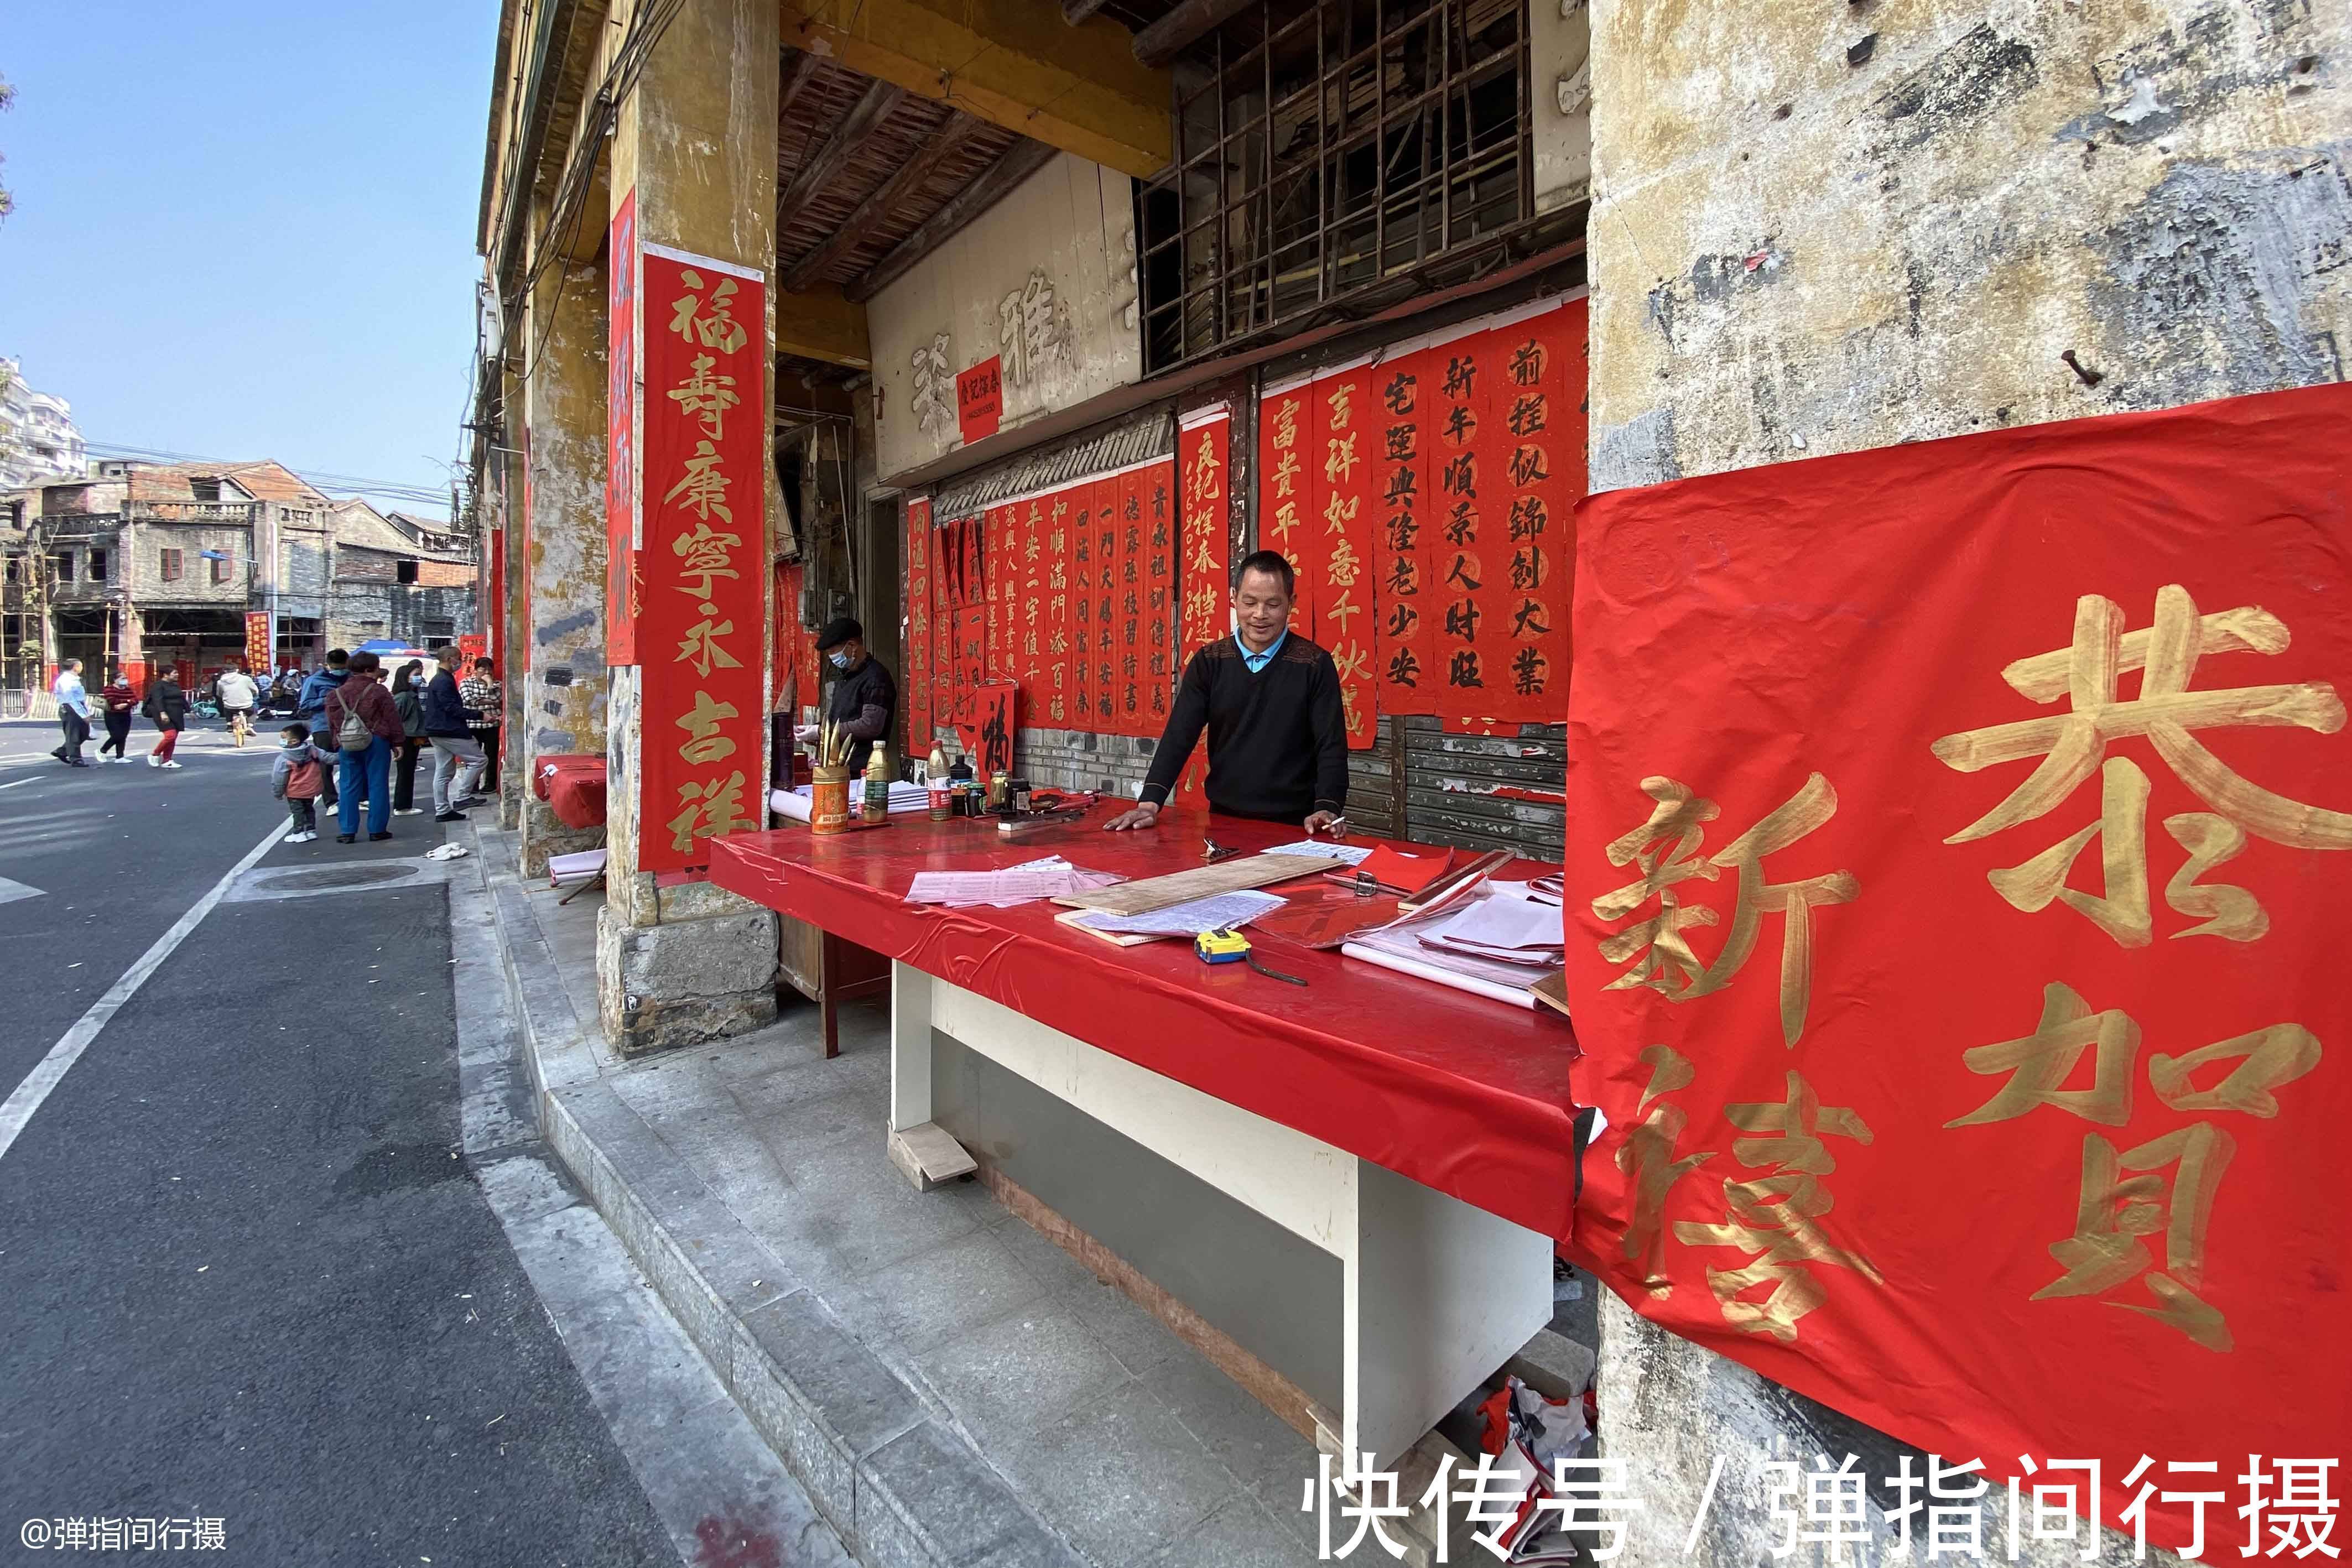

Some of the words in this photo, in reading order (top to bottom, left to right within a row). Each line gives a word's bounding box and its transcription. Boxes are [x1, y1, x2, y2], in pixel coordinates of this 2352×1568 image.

[1023, 501, 1043, 721] 平安二字值千金
[1049, 496, 1069, 721] 和順滿門添百福
[1271, 398, 1301, 628] 富貴平
[1443, 356, 1484, 688] 新年順景人財旺
[1509, 338, 1552, 696] 前程似錦創大業
[1591, 772, 1884, 1340] 新禧
[1930, 584, 2352, 1353] 恭賀
